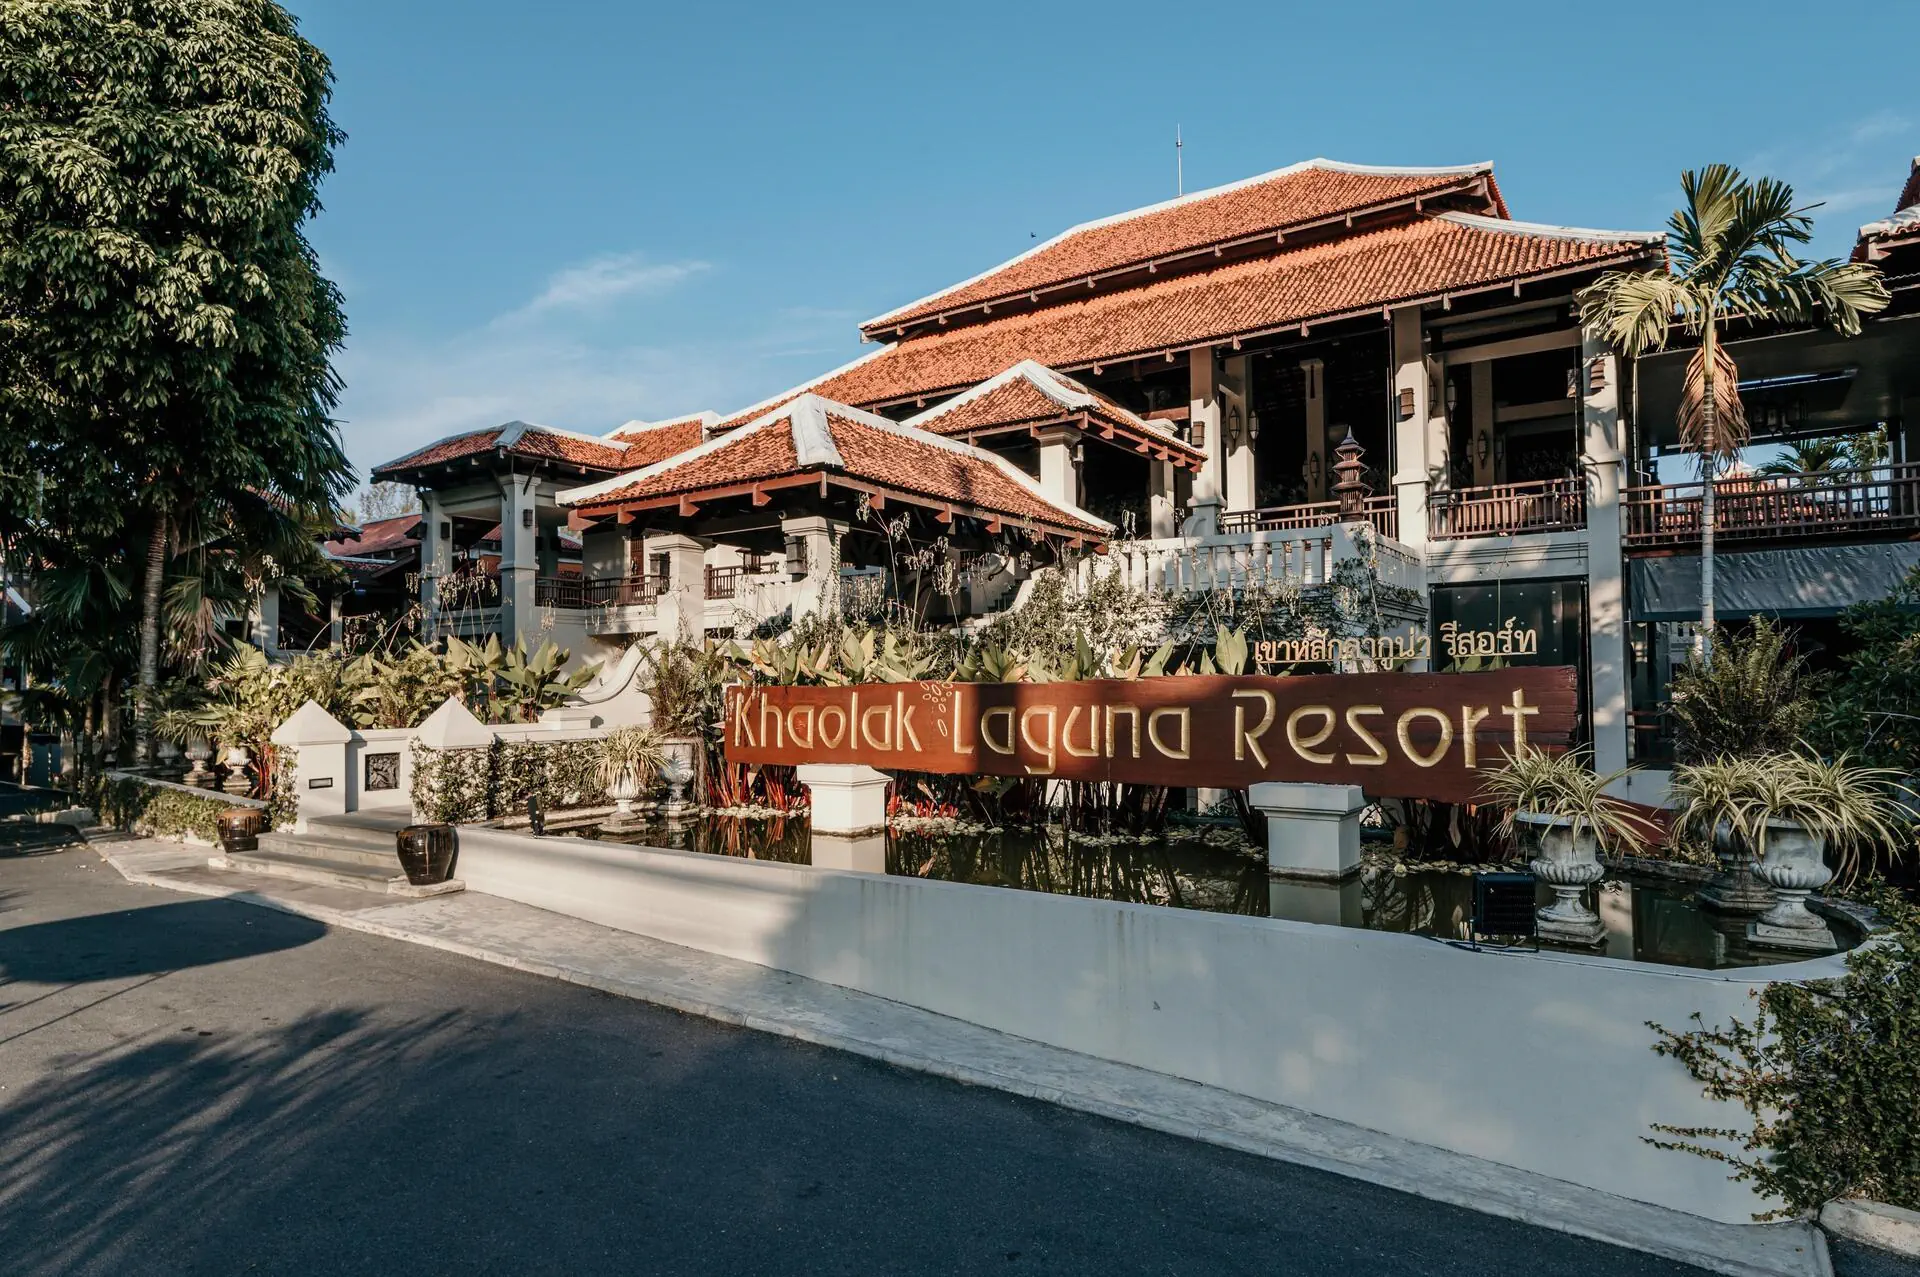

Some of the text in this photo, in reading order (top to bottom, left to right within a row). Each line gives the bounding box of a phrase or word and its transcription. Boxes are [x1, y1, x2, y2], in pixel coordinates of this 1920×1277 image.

[1439, 616, 1538, 656] รีสอร์ท
[733, 688, 1540, 775] Khaolak Laguna Resort
